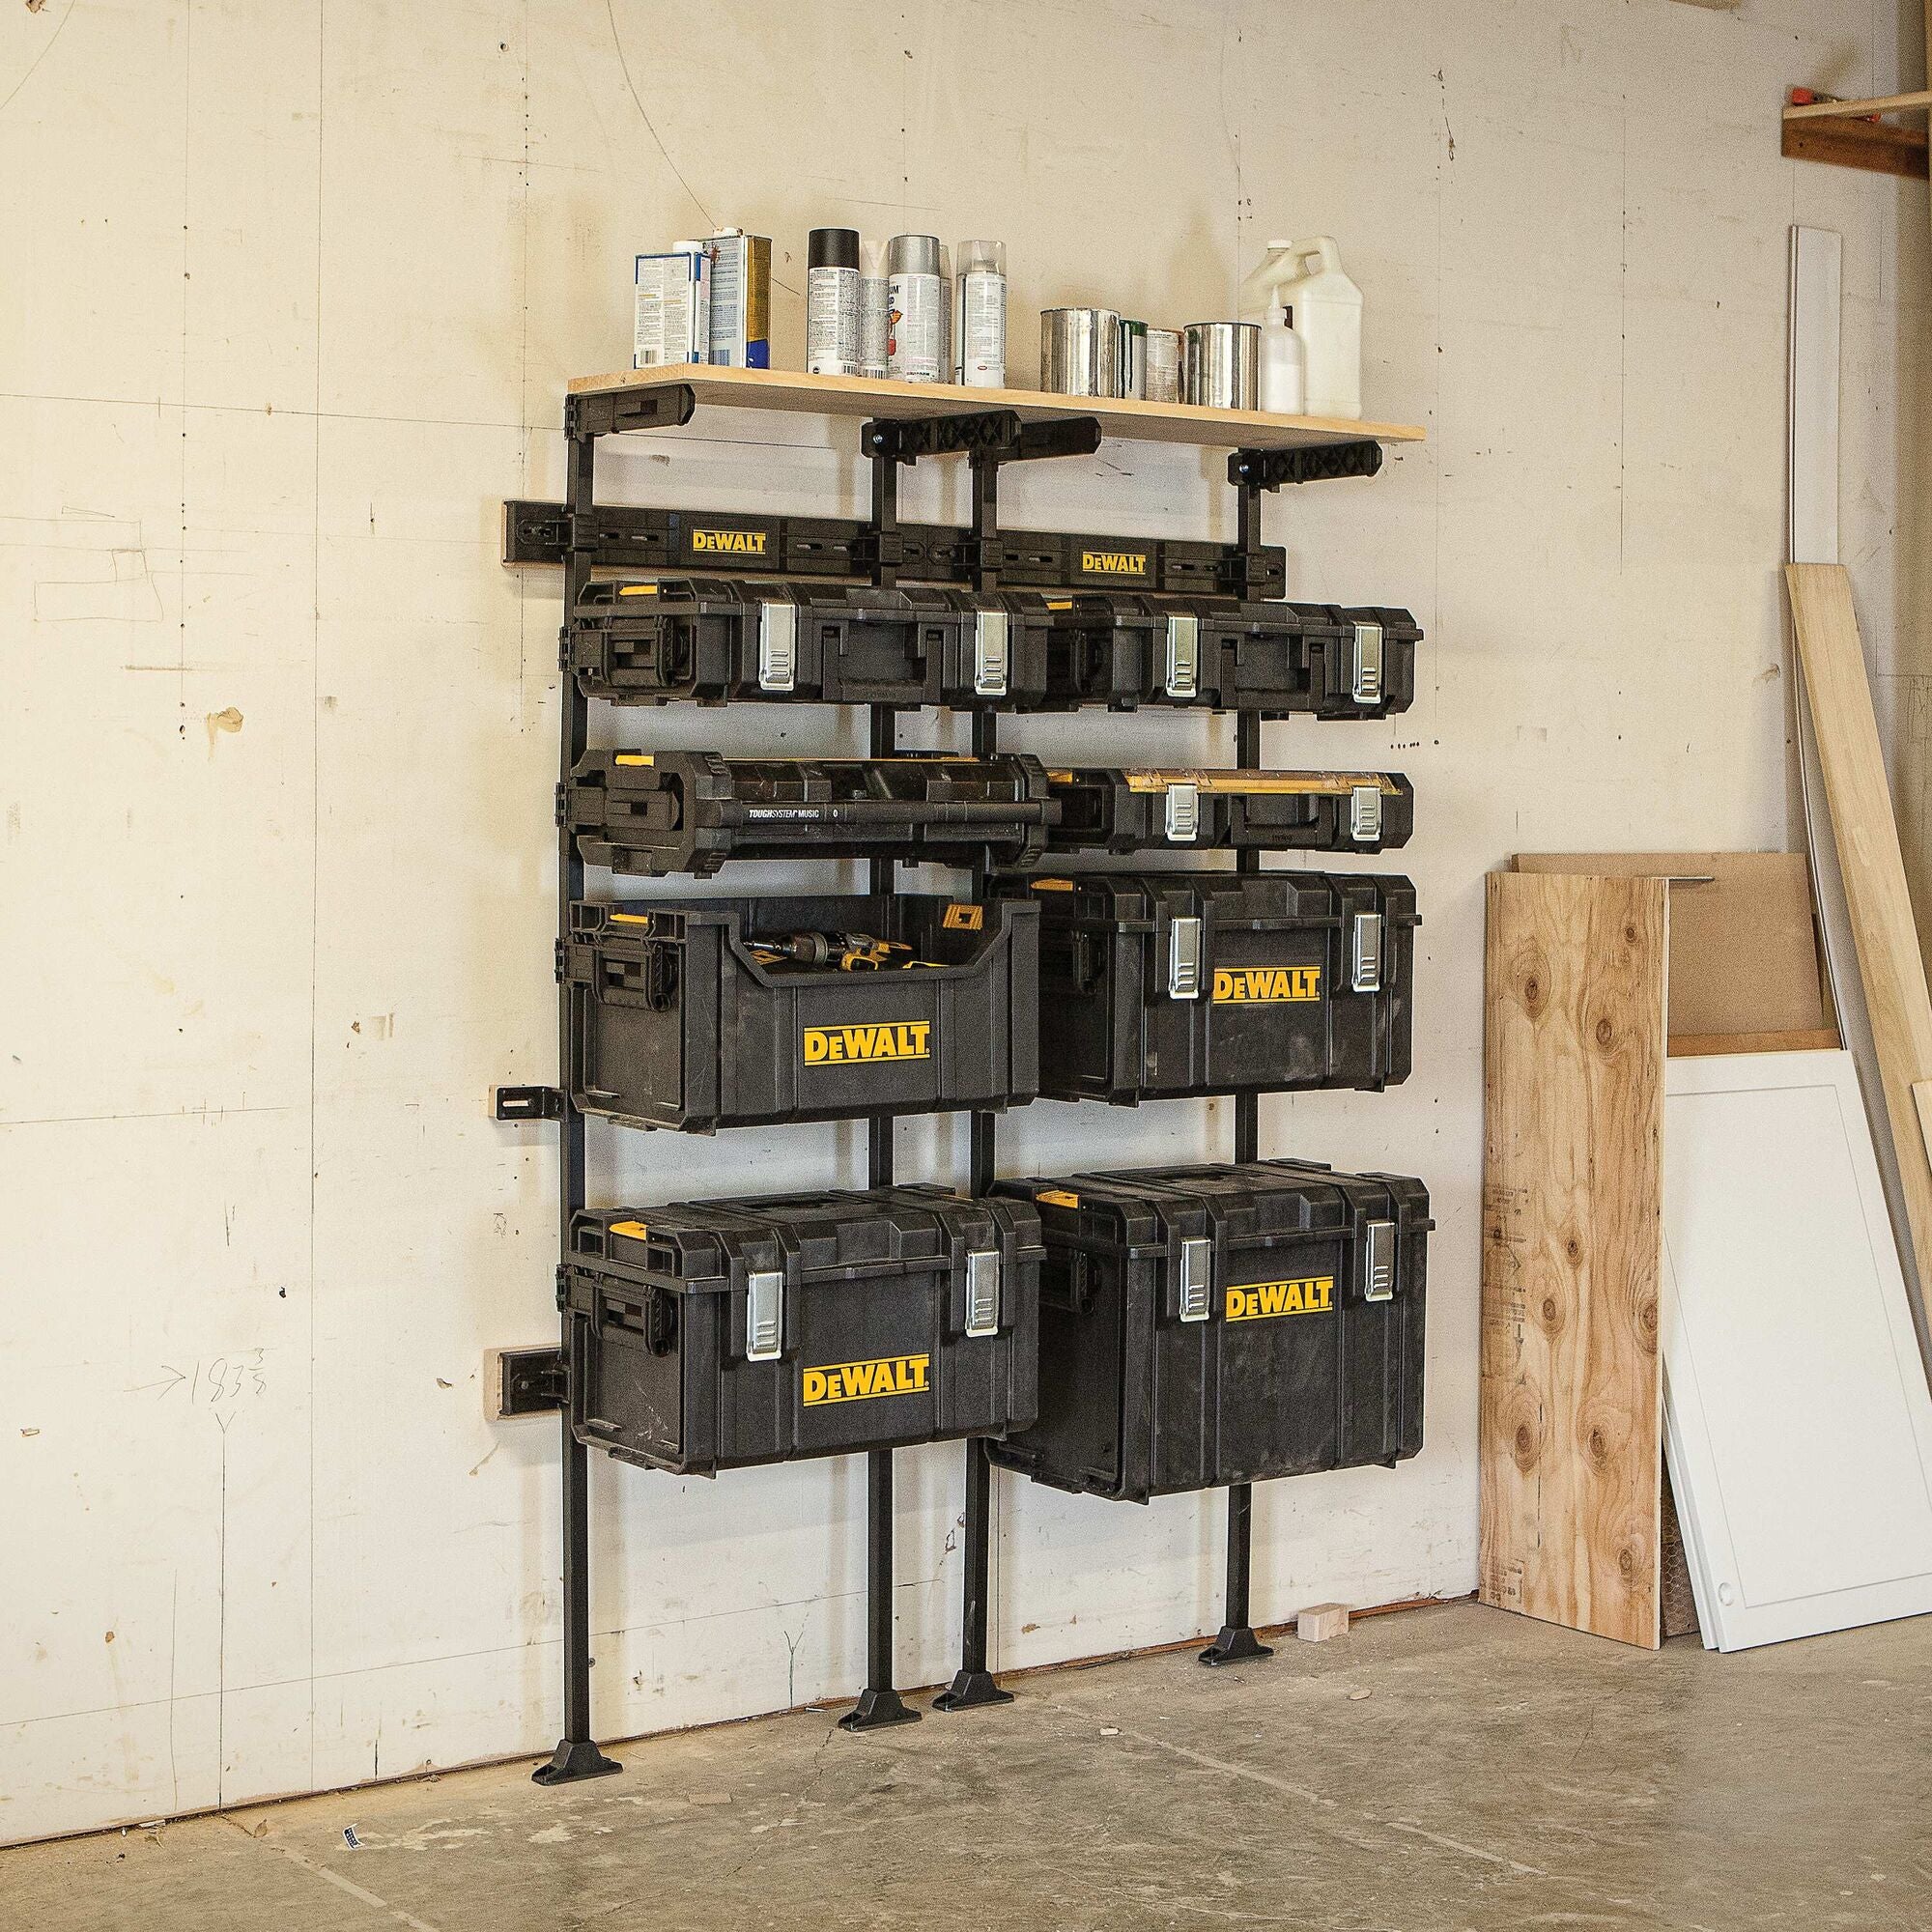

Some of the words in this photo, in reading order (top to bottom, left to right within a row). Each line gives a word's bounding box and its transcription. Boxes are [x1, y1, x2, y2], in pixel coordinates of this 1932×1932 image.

[693, 531, 766, 552] DEWALT
[1082, 554, 1146, 573] DEWALT
[798, 809, 819, 818] MUSIC
[1213, 971, 1321, 999] DEWALT
[804, 1026, 930, 1061] DEWALT
[1226, 1280, 1333, 1319] DEWALT
[804, 1357, 929, 1402] DEWALT
